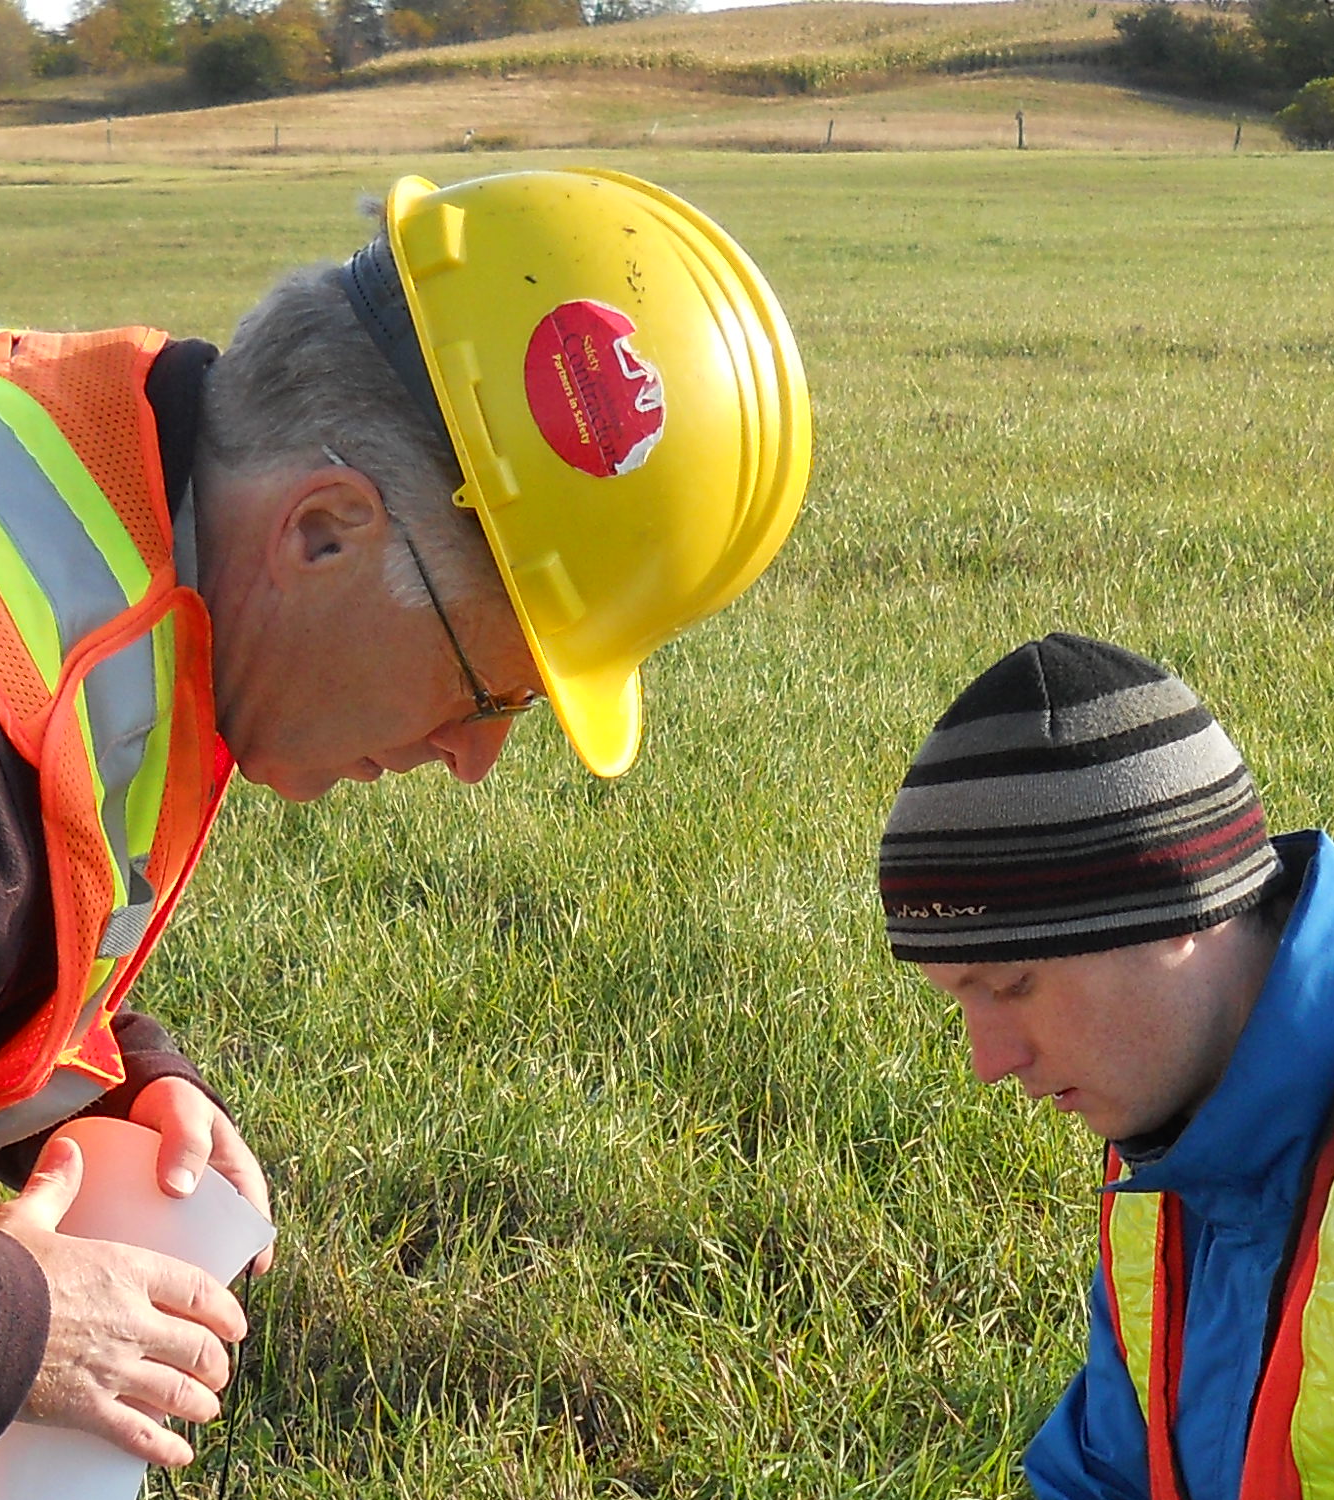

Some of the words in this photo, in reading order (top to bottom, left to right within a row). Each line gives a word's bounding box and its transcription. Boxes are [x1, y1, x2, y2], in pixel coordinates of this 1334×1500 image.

[582, 335, 601, 372] Safety
[552, 353, 574, 398] Partners
[572, 410, 591, 445] Safety
[932, 902, 987, 918] River
